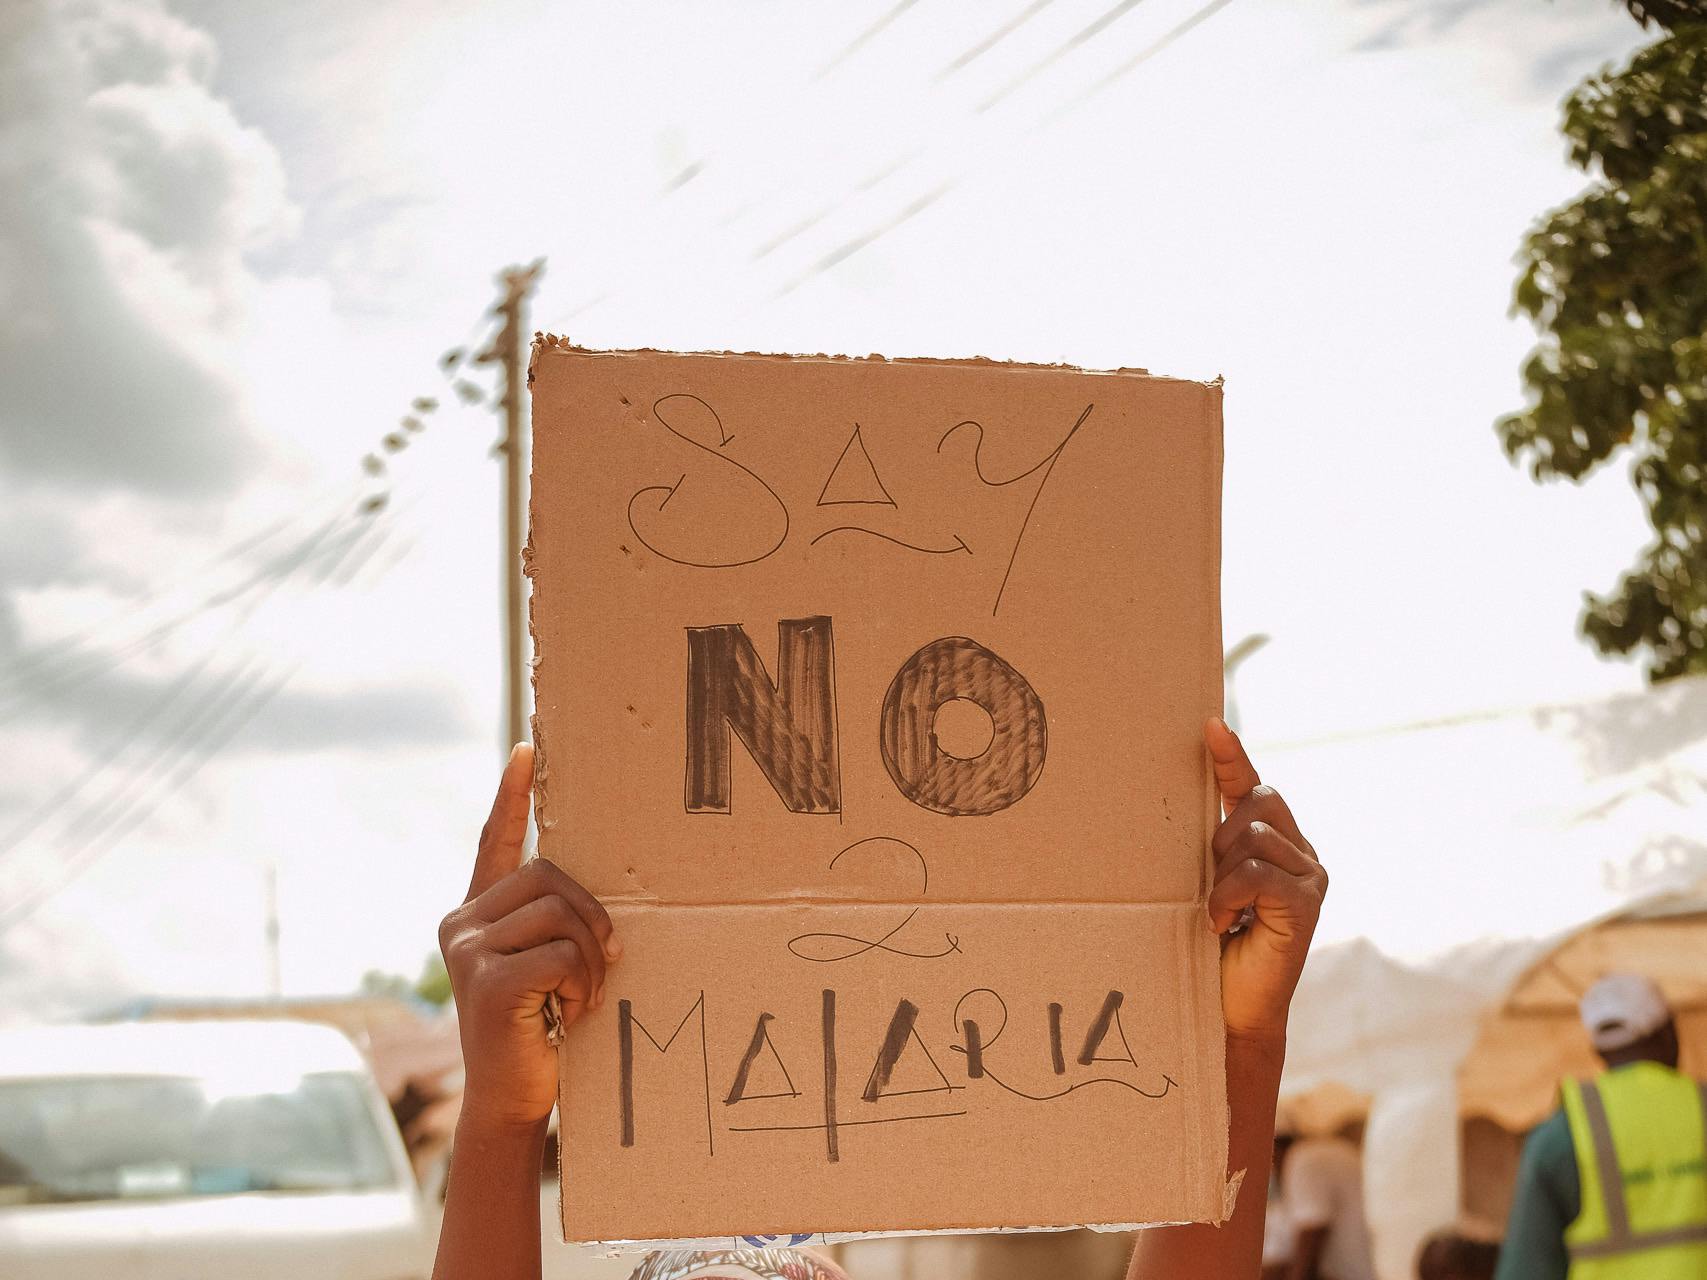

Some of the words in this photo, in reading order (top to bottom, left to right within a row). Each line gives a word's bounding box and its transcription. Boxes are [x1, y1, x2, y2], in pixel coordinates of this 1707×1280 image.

[627, 393, 1094, 617] SAY
[683, 615, 1048, 825] NO
[787, 836, 963, 962] 2
[618, 988, 1179, 1162] MALARIA
